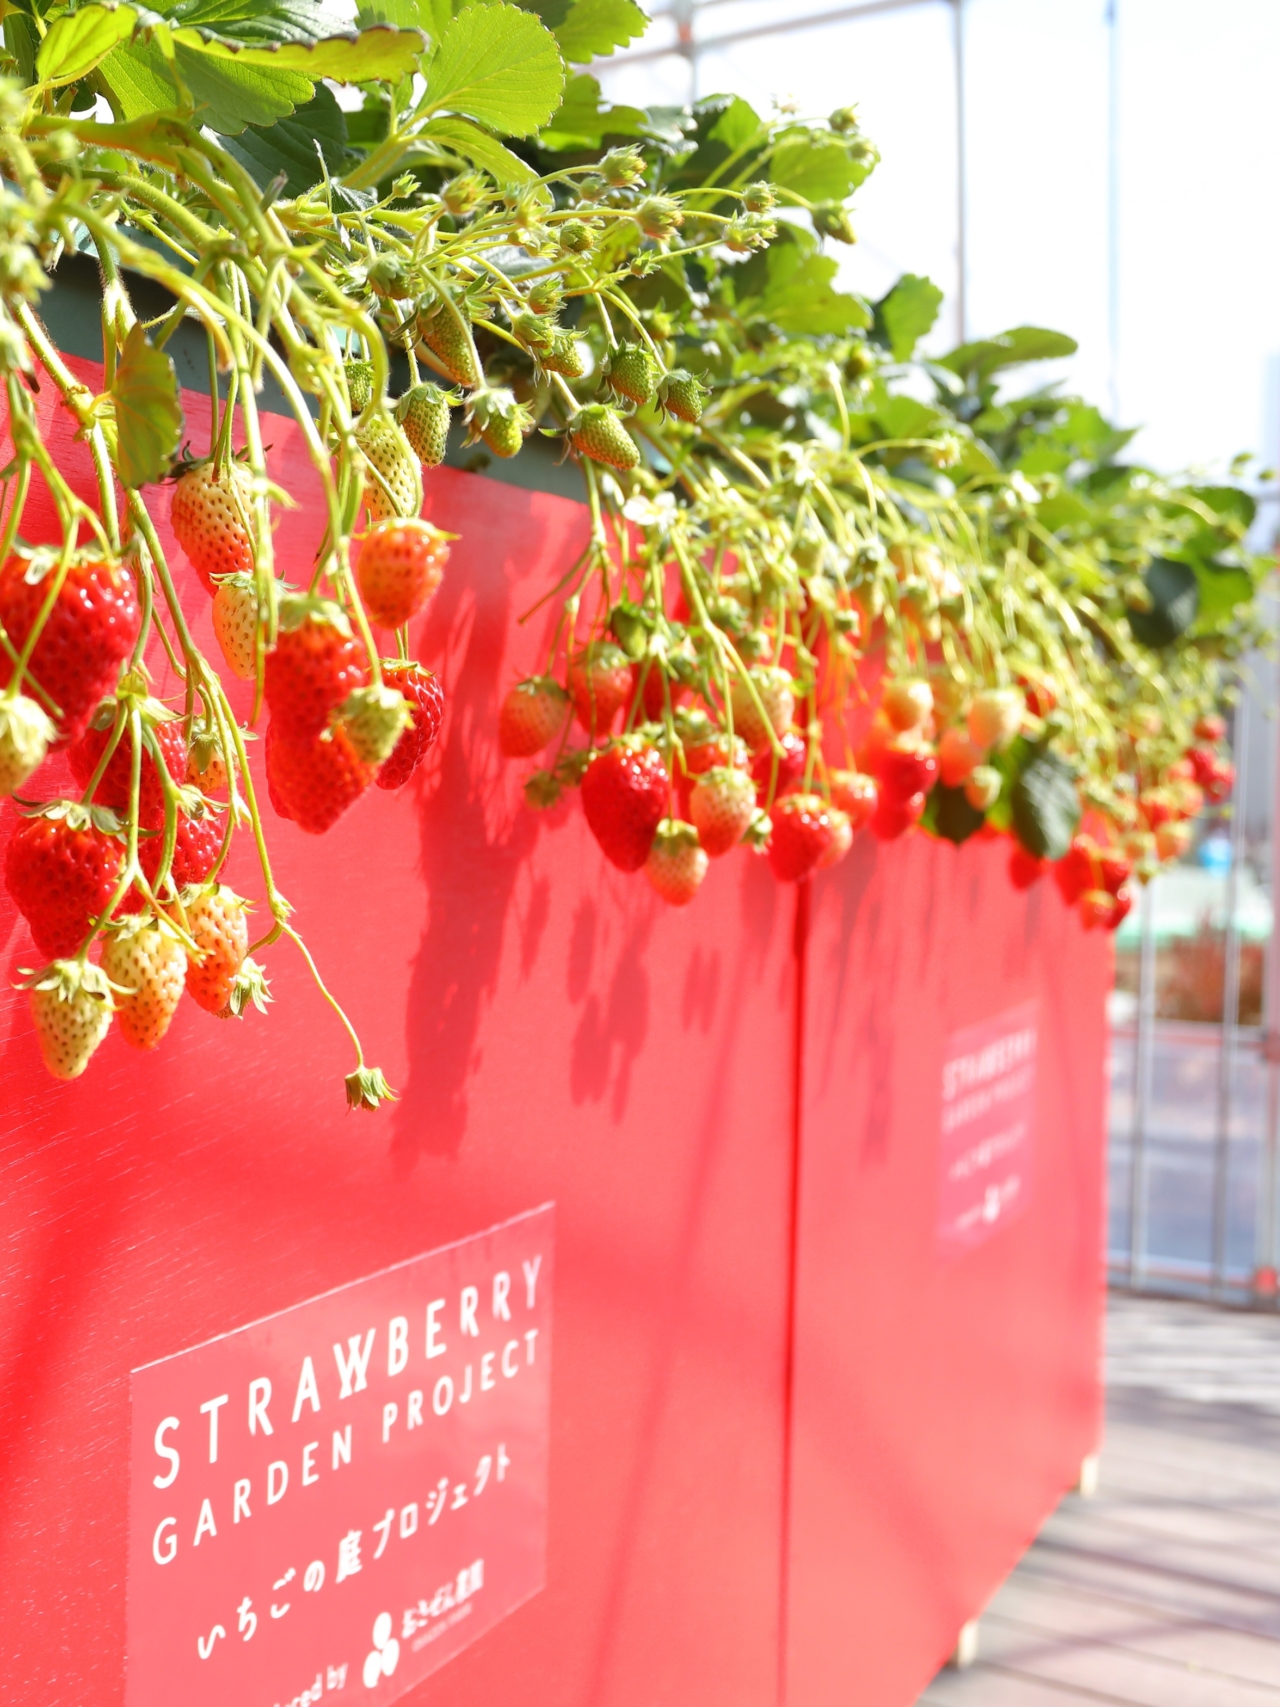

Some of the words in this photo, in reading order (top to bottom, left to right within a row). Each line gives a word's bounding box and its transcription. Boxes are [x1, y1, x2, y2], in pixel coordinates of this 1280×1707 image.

[152, 1424, 353, 1566] GARDEN
[382, 1328, 539, 1443] PROJECT
[153, 1255, 542, 1490] STRAWBERRY
